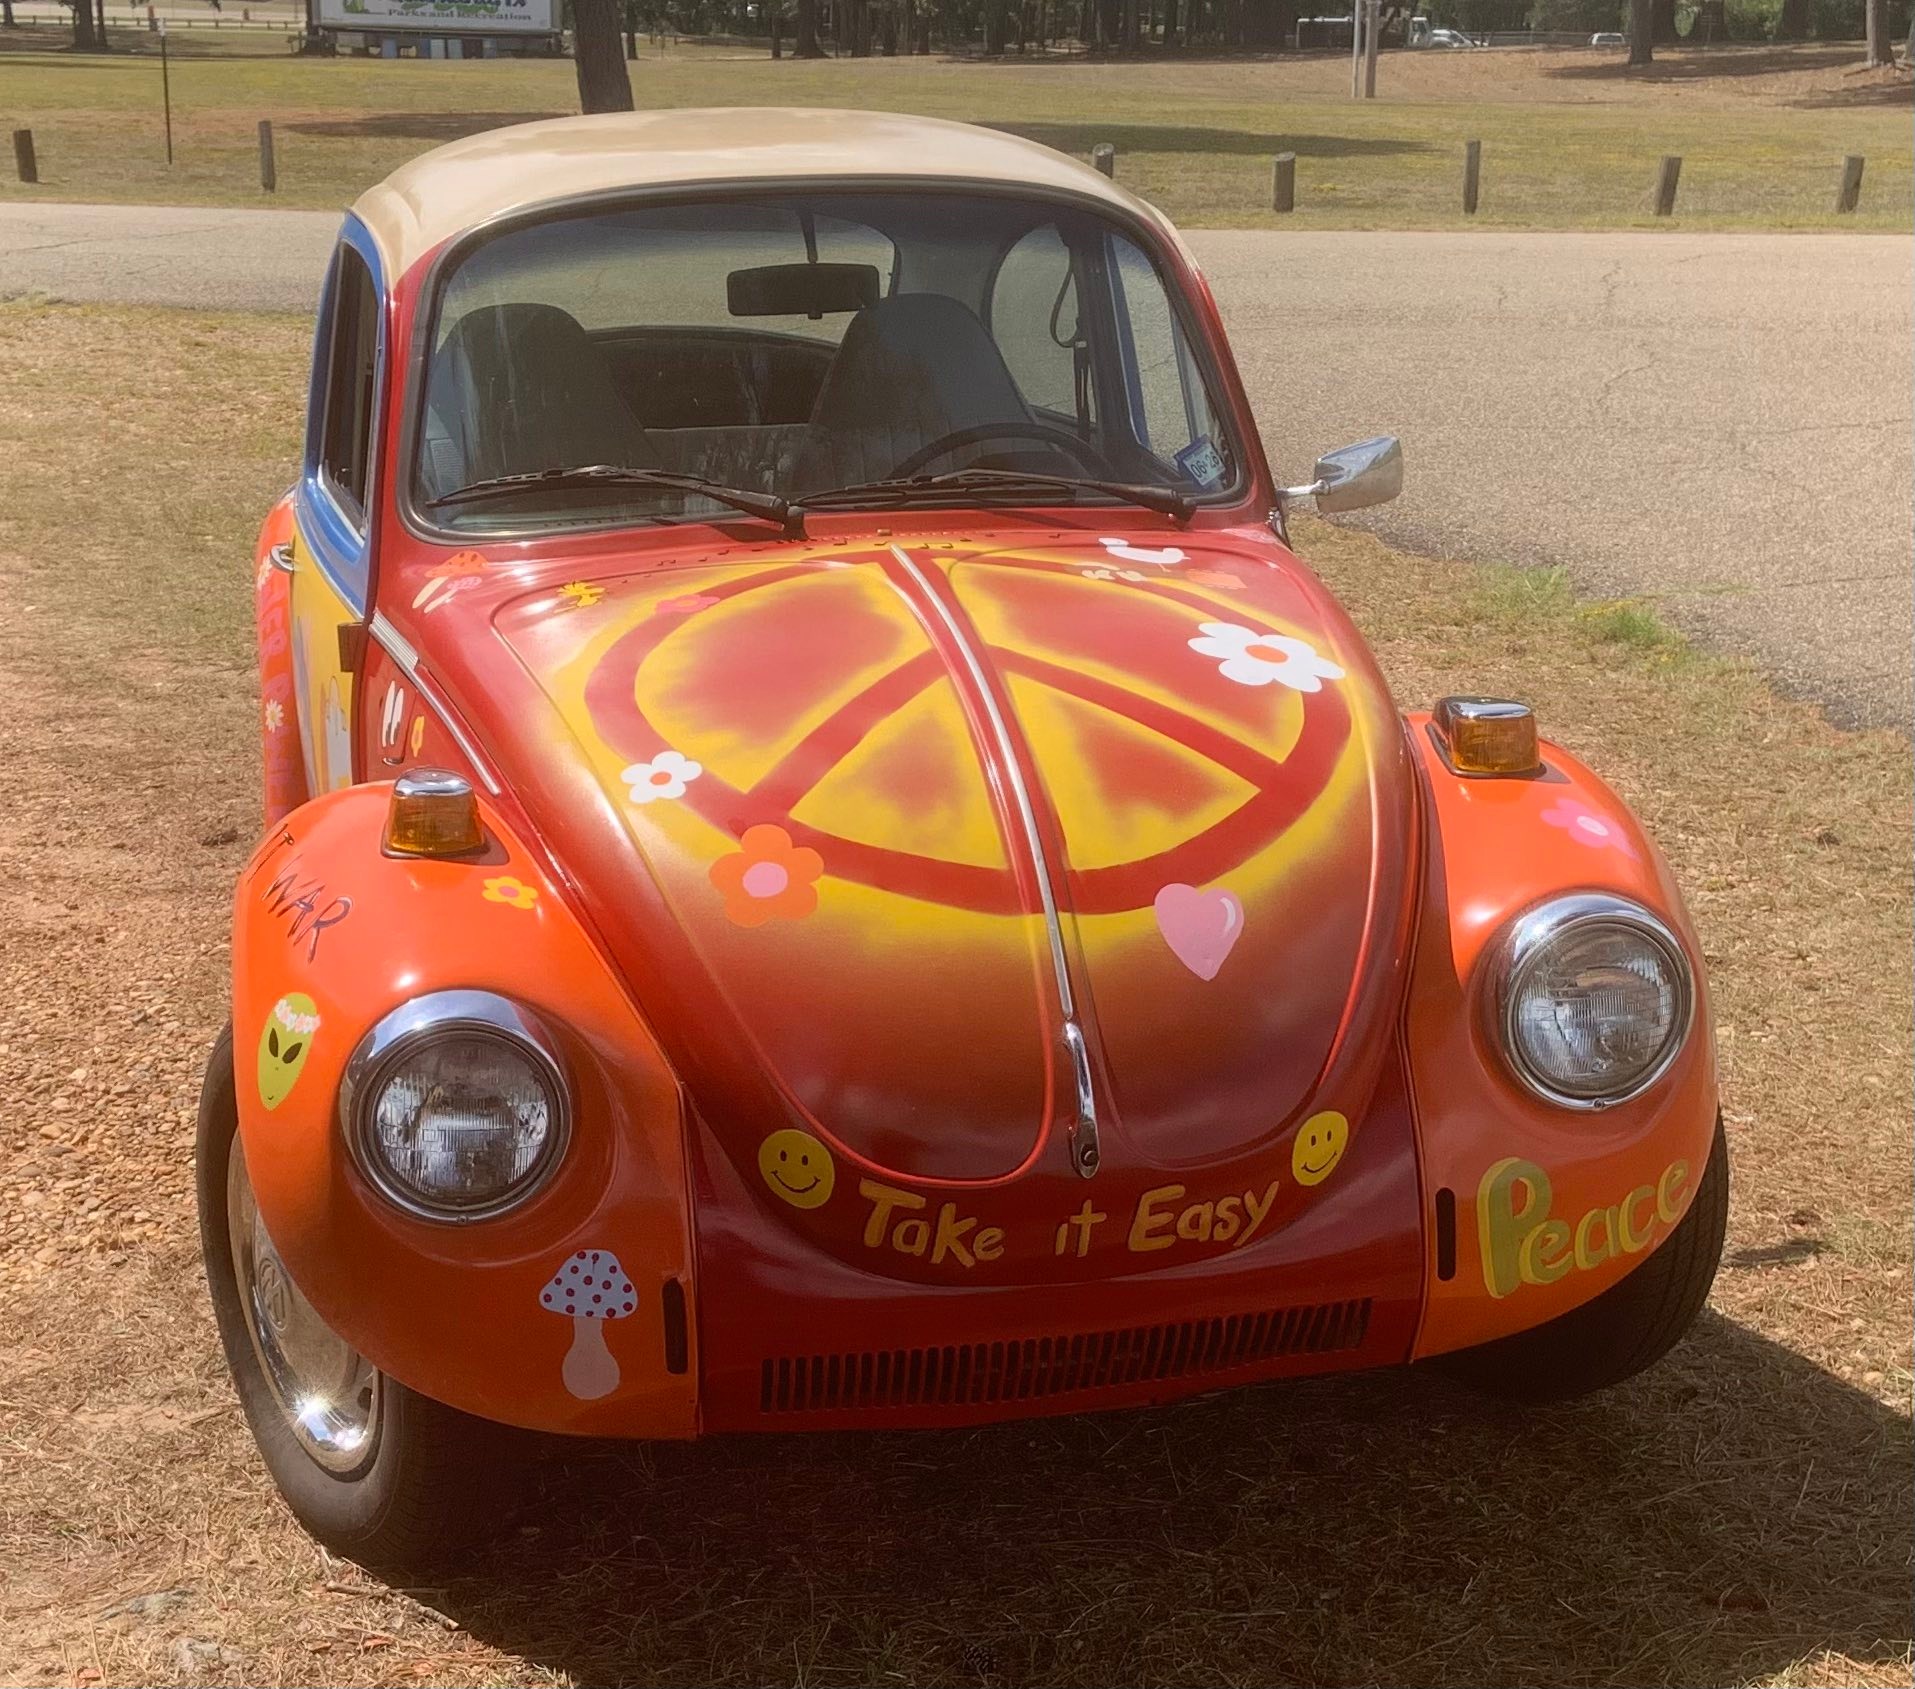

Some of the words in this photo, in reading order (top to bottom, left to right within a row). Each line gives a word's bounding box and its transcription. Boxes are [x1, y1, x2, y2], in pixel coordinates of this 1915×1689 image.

[388, 9, 425, 17] Parks
[429, 10, 454, 18] and
[457, 10, 531, 21] Recreation
[261, 854, 354, 964] WAR
[859, 1179, 1006, 1268] Take
[1055, 1199, 1107, 1257] it
[1127, 1181, 1280, 1252] Easy
[1477, 1157, 1691, 1299] Peace
